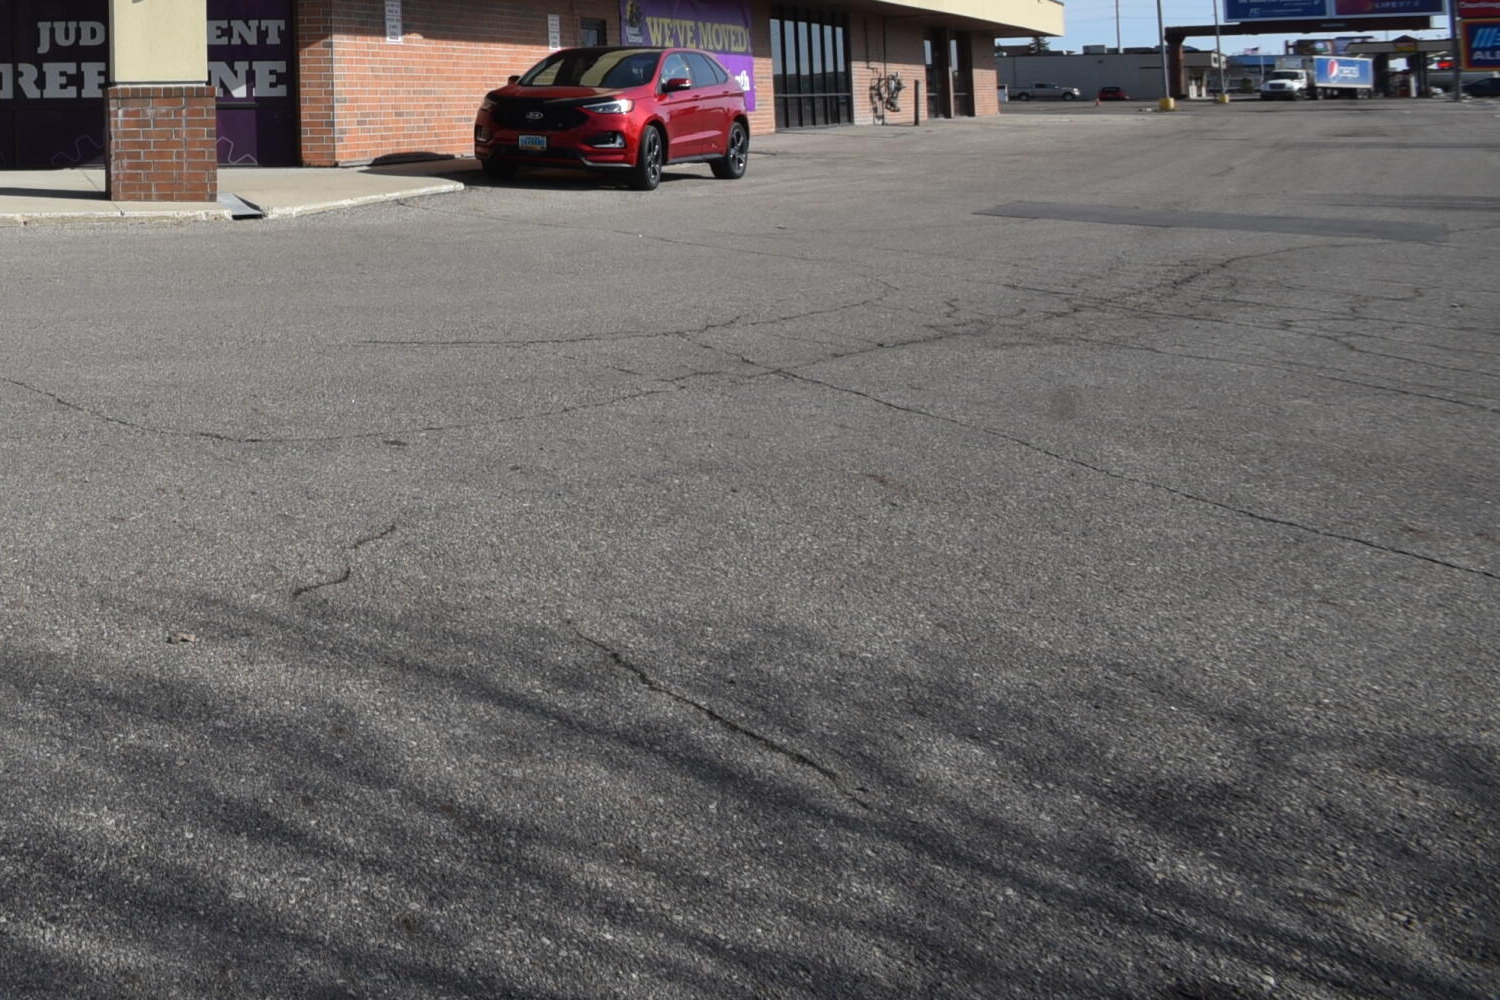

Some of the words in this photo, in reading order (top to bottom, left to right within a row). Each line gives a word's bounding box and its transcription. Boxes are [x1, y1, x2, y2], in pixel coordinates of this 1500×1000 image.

[36, 19, 286, 54] JUDENT
[645, 16, 696, 48] WE'VE
[698, 21, 752, 53] MOVED!
[208, 60, 288, 98] NE
